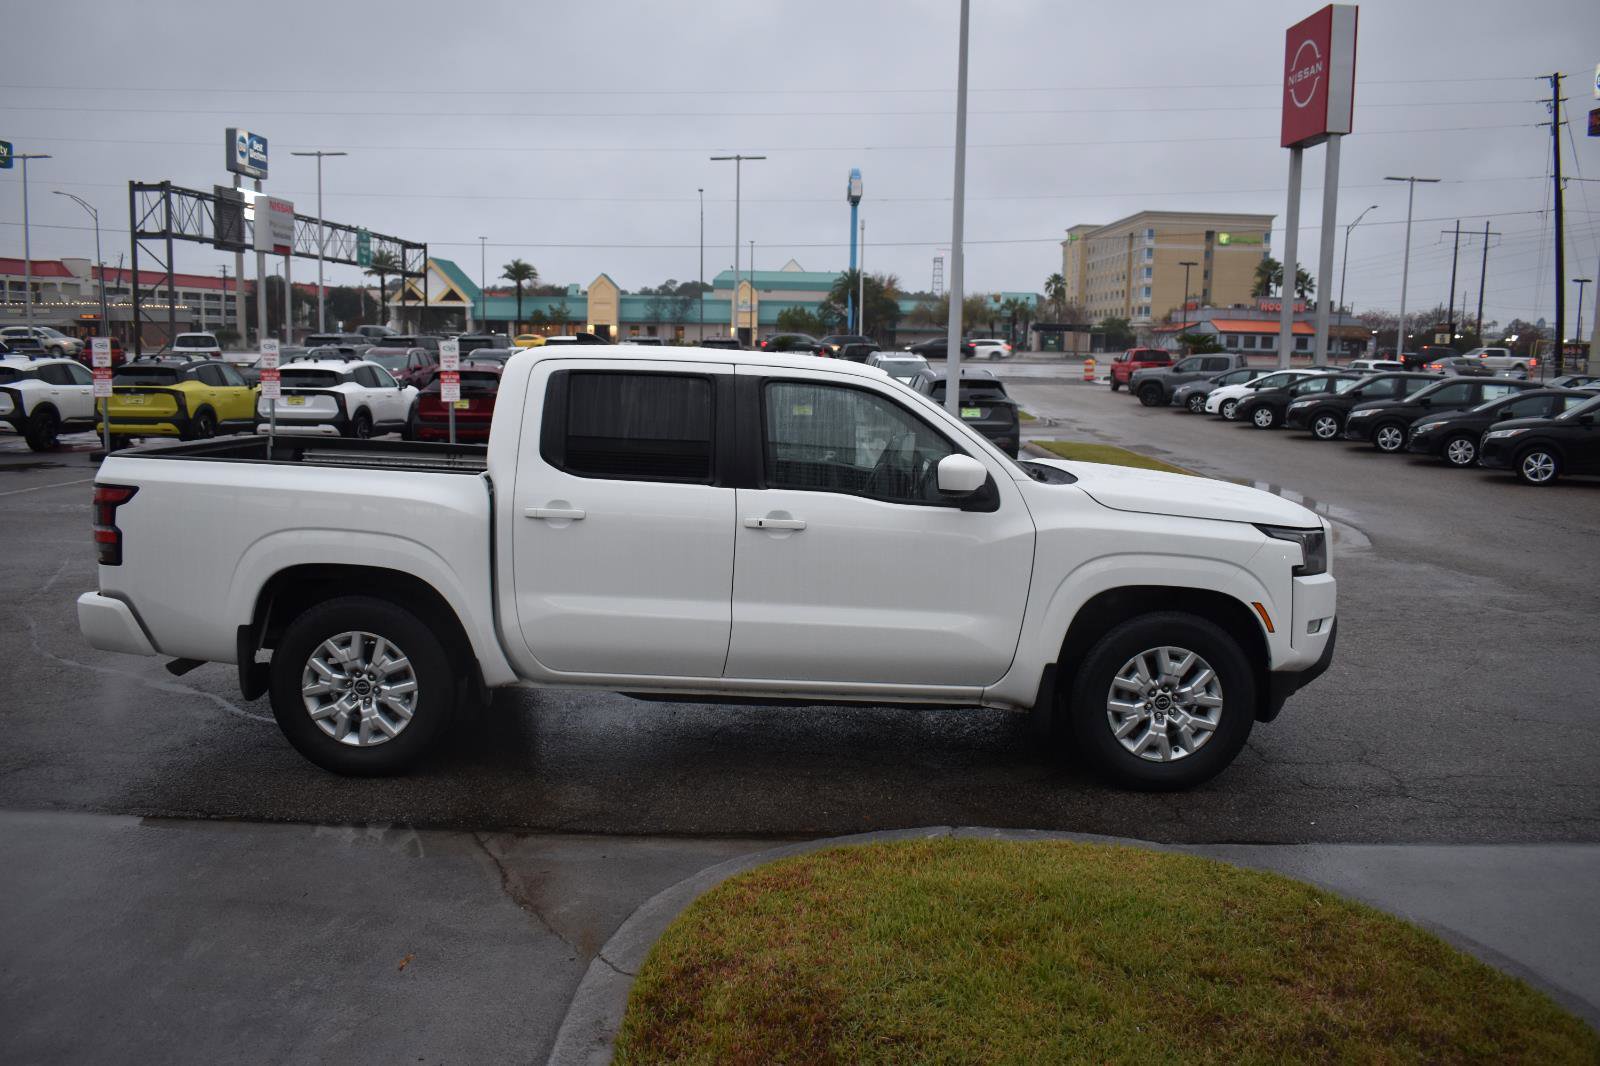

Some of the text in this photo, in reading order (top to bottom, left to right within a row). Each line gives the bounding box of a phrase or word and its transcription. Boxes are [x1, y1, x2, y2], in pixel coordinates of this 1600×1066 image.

[1288, 61, 1322, 86] NISSAN
[253, 140, 264, 152] Best
[268, 200, 294, 213] NISSAN
